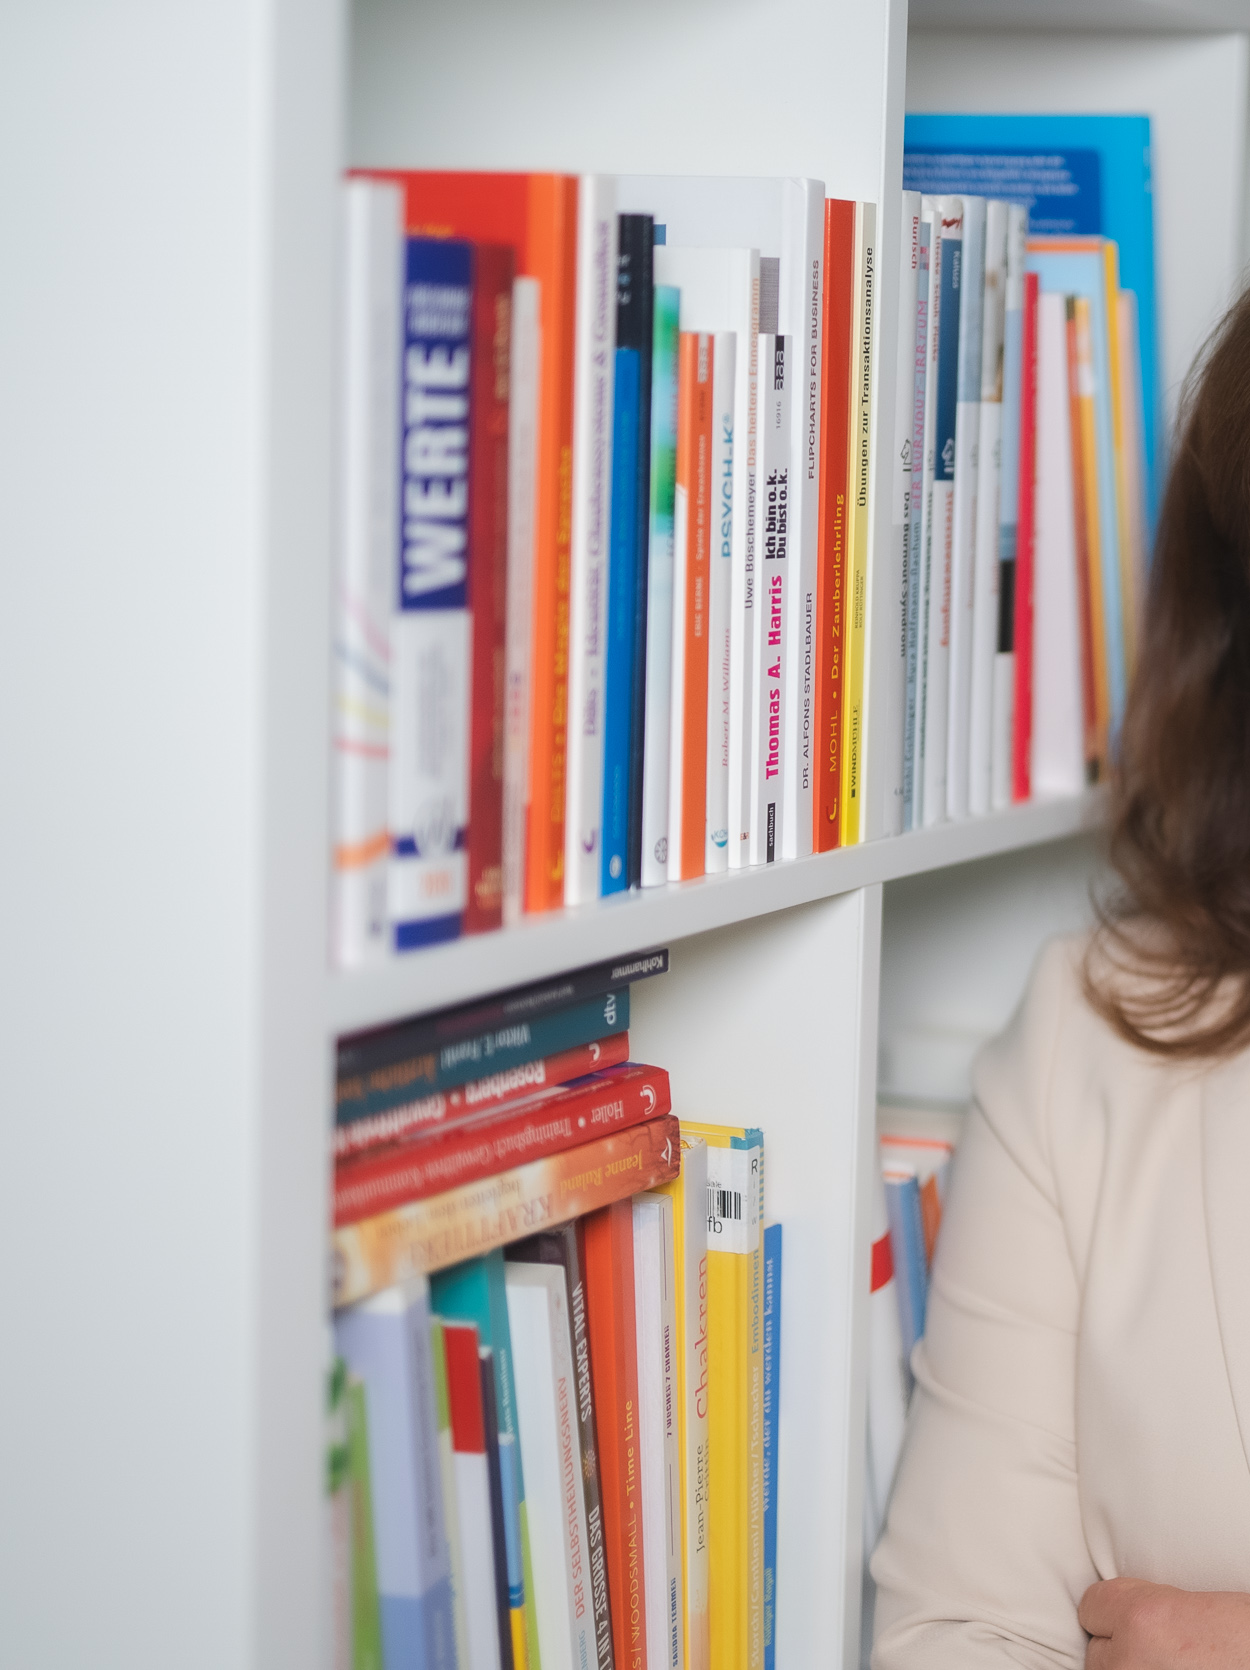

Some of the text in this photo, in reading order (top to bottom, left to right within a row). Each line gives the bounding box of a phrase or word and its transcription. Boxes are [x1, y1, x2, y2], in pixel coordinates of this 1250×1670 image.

[911, 216, 919, 270] Burisch
[861, 246, 874, 406] Transaktionsanalyse
[808, 259, 819, 480] FLIPCHARTS FOR BUSINESS
[403, 343, 469, 598] WERTE
[744, 276, 760, 609] Uwe Böschemeyer Das heitere Enneagramm
[857, 438, 869, 507] Übungen
[765, 468, 778, 560] Ich bin o.k.
[776, 467, 788, 560] Du bist o.k.
[911, 480, 921, 510] DER
[694, 576, 703, 610] BERNE
[899, 523, 910, 658] Burnout-Syndrom
[694, 612, 702, 637] ERIC
[804, 591, 813, 695] STADLBAUER
[829, 493, 844, 773] MOHL Der Zauberlehrling
[722, 628, 731, 692] Williams
[765, 575, 783, 781] Thomas A. Harris
[721, 720, 729, 767] Robert
[803, 698, 811, 759] ALFONS
[603, 955, 663, 980] Kohlhammer
[603, 993, 618, 1025] dtv
[590, 1100, 624, 1125] Holler
[559, 1149, 643, 1198] Jeanne Ruland
[571, 1280, 589, 1339] VITAL
[751, 1248, 760, 1355] Embodimen
[763, 1257, 774, 1316] kannst
[694, 1253, 708, 1420] Chakren
[763, 1320, 773, 1386] werden
[575, 1342, 592, 1423] EXPERTS
[664, 1376, 671, 1384] 7
[750, 1366, 760, 1451] Tschacher
[624, 1400, 634, 1441] Line
[558, 1376, 582, 1578] SELBSTHEILUNGSNERV
[624, 1446, 636, 1497] Time
[695, 1444, 707, 1553] Jean-Pierre
[587, 1505, 602, 1544] DAS
[573, 1578, 586, 1620] DER
[590, 1544, 607, 1618] GROSSE
[627, 1514, 641, 1645] WOODSMALL
[596, 1619, 608, 1635] 4
[597, 1632, 610, 1660] IN
[751, 1612, 760, 1667] Storch
